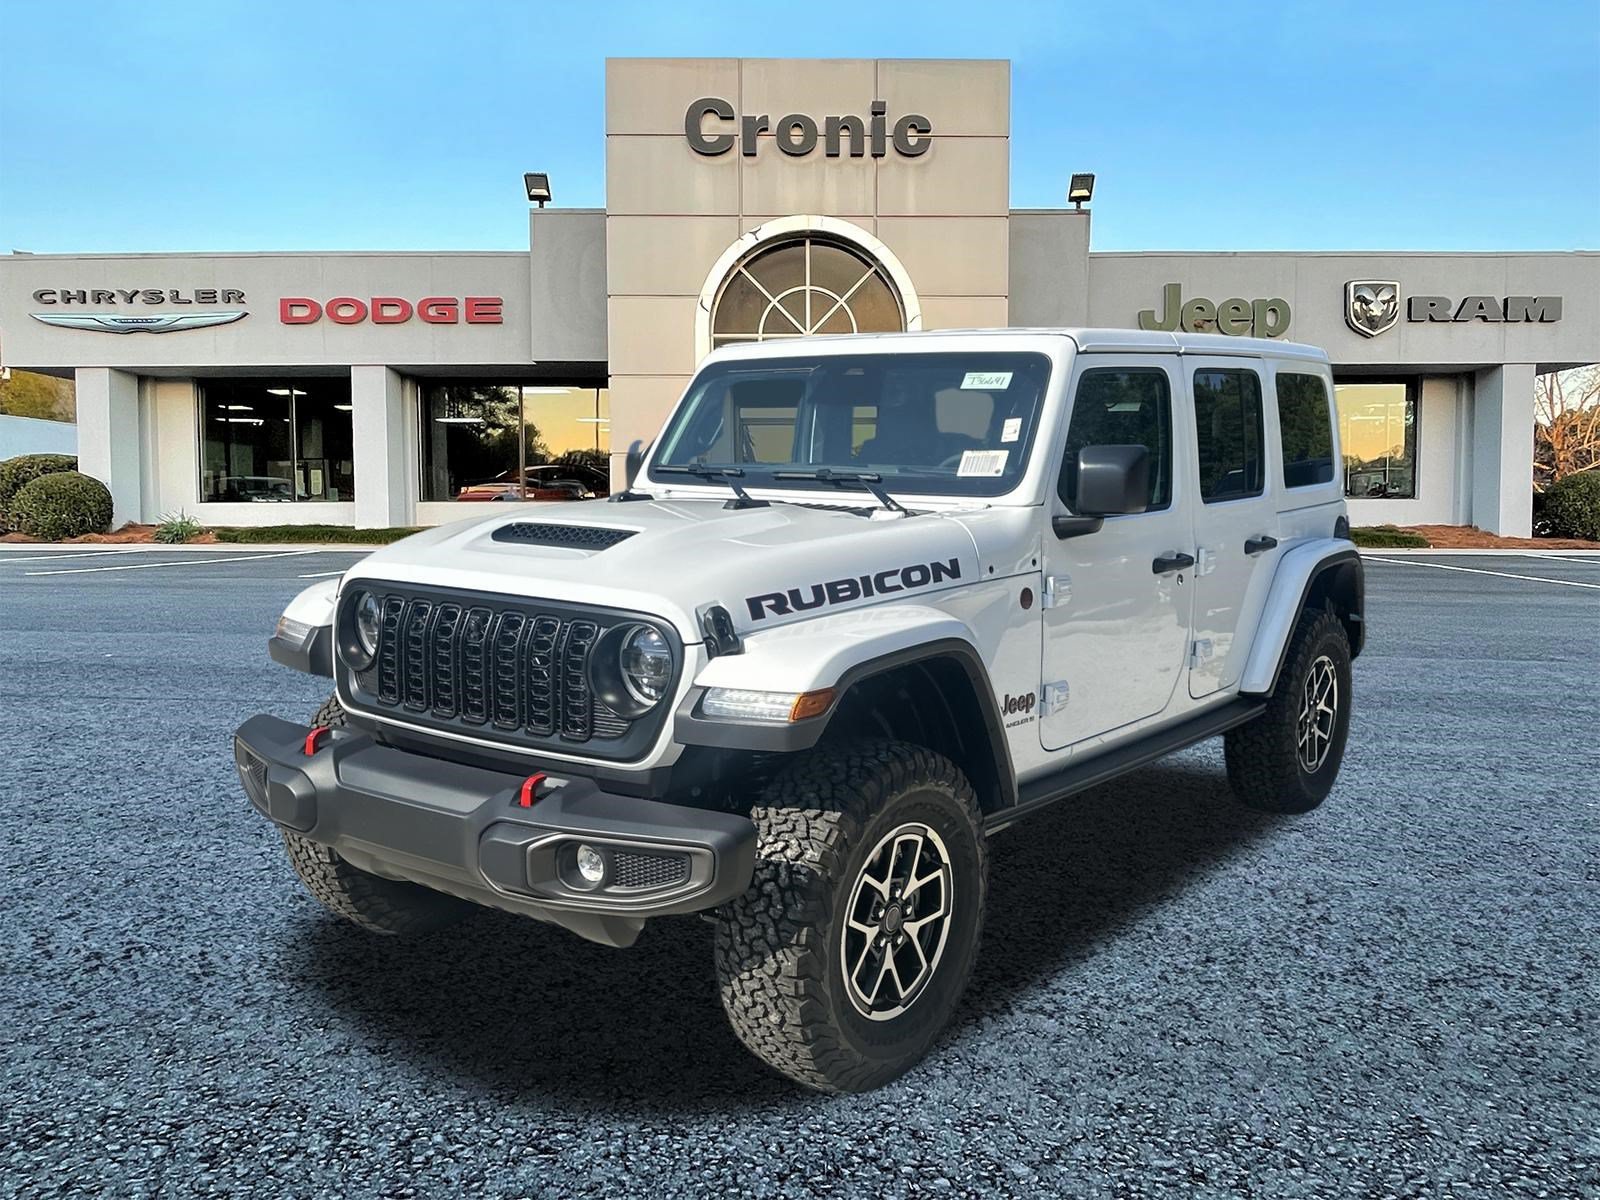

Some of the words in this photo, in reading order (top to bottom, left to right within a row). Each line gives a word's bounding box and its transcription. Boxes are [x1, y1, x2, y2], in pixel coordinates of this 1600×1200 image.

[685, 97, 932, 157] Cronic
[32, 289, 246, 304] CHRYSLER
[1407, 296, 1563, 322] RAM
[279, 297, 503, 324] DODGE
[1138, 283, 1291, 338] Jeep
[745, 558, 961, 621] RUBICON
[1000, 692, 1036, 716] Jeep
